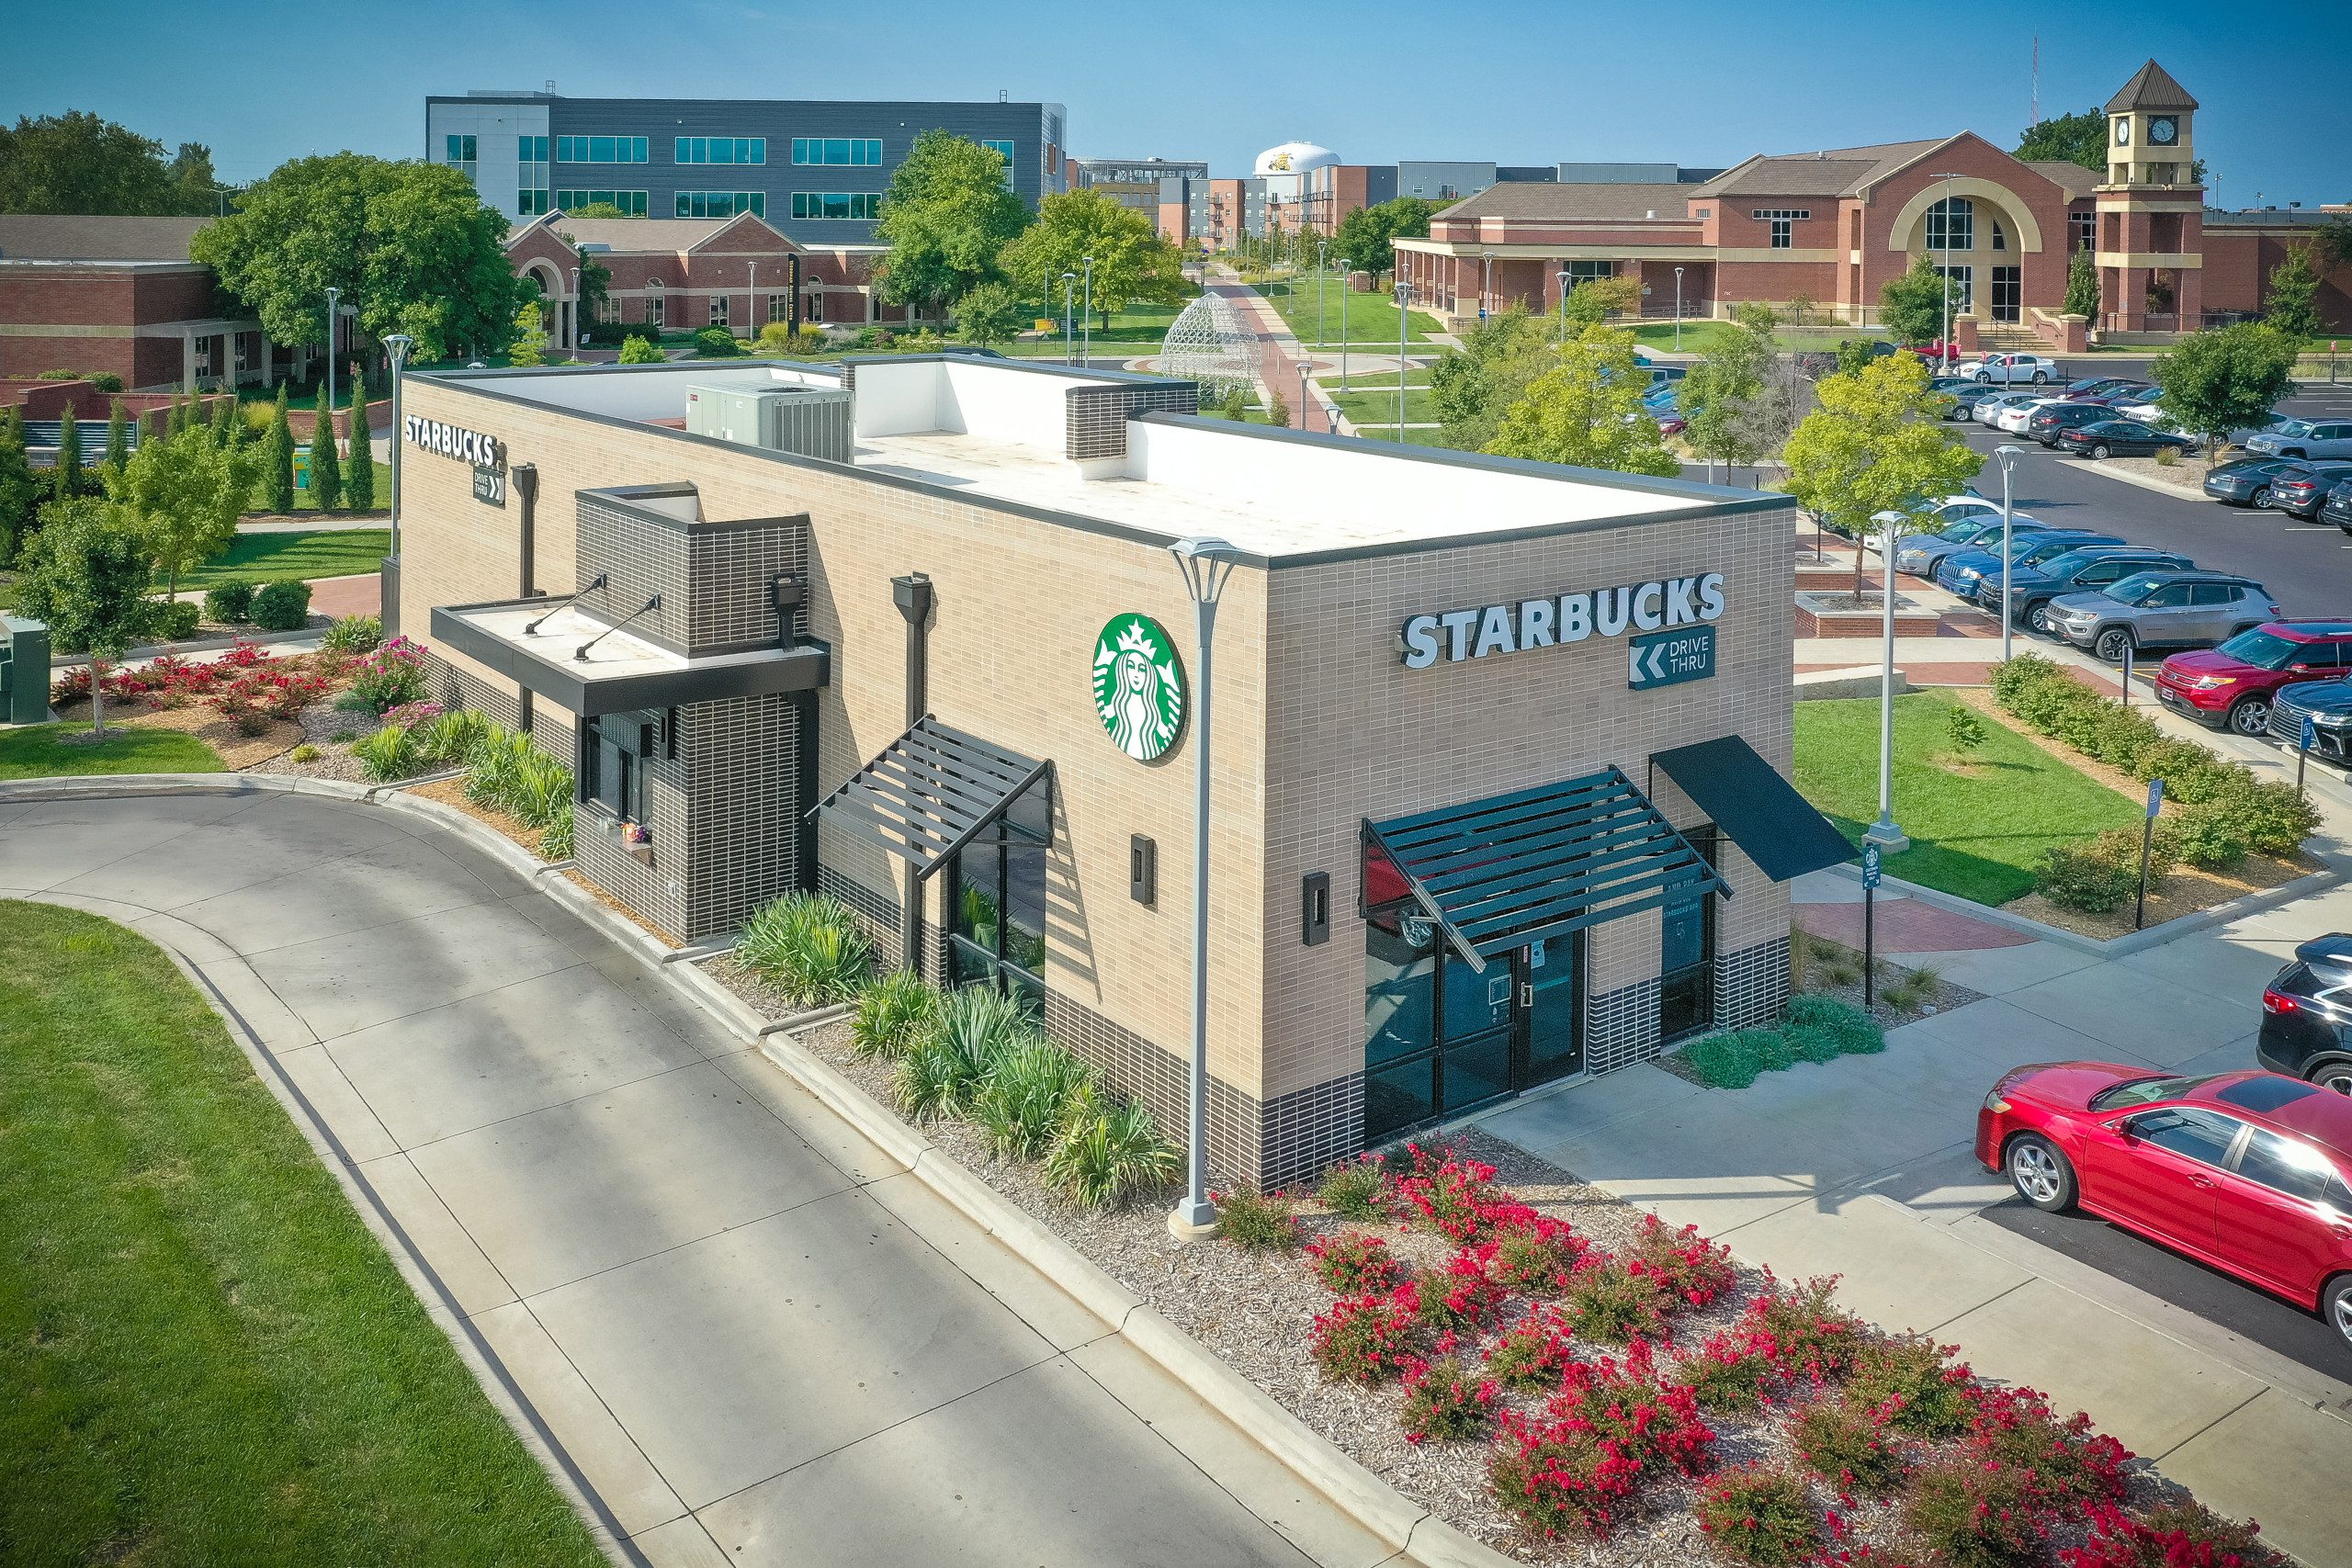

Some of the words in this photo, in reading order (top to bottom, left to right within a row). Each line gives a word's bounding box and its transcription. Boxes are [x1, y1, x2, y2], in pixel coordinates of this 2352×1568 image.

[405, 414, 493, 466] STARBUCKS
[475, 472, 488, 485] DRIVE
[475, 483, 488, 496] THRU
[1403, 572, 1725, 669] STARBUCKS
[1669, 636, 1709, 657] DRIVE
[1670, 653, 1706, 674] THRU
